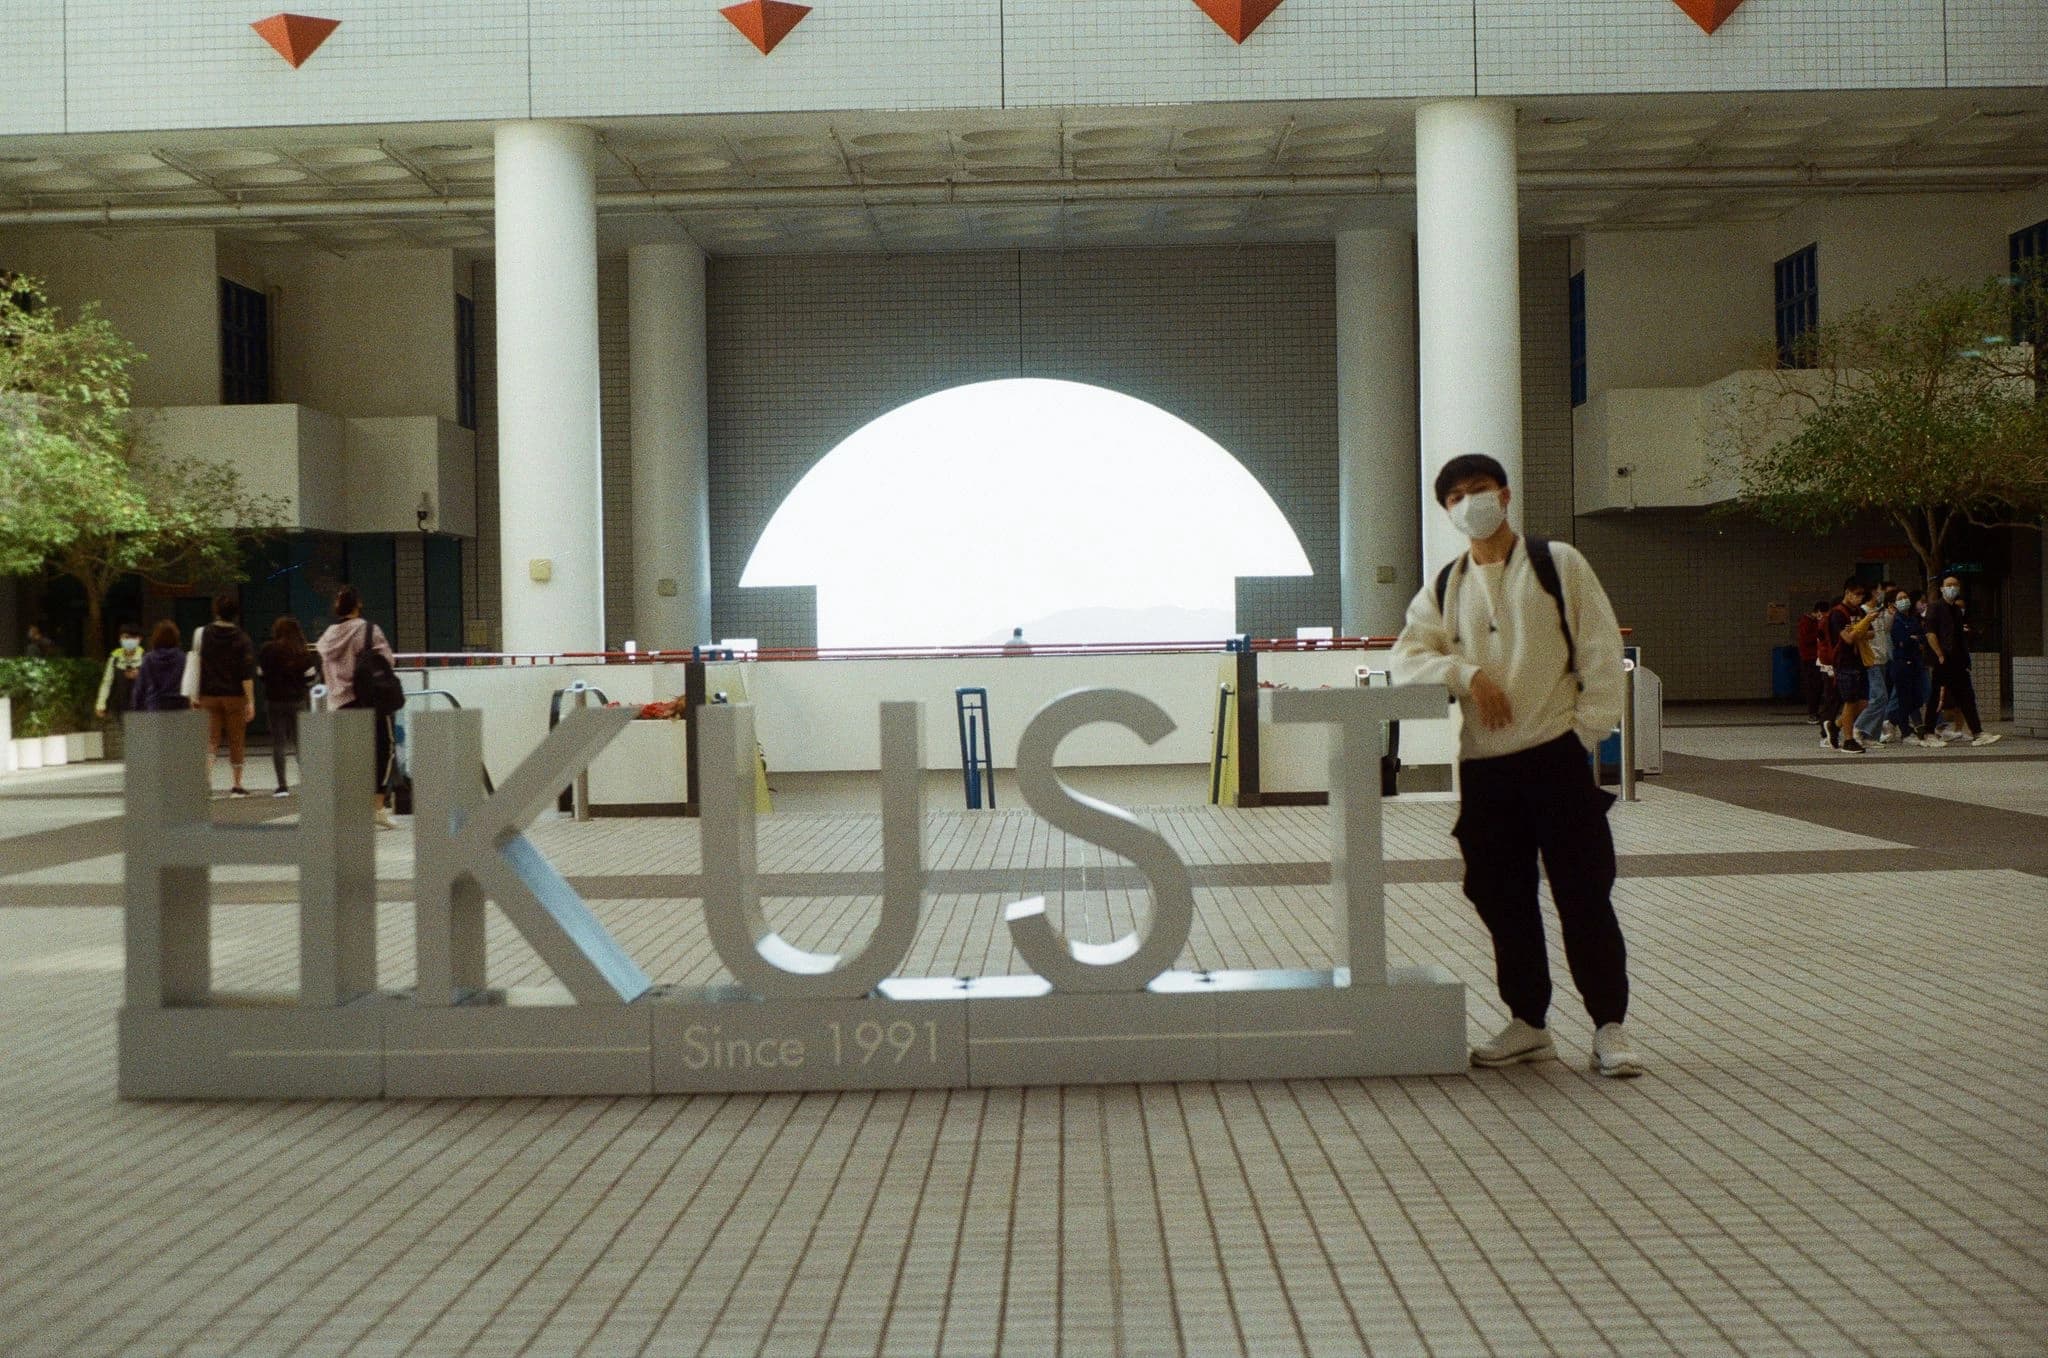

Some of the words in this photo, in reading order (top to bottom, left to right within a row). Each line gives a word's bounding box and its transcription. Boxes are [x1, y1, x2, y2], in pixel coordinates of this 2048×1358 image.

[122, 685, 1450, 1007] HKUST
[683, 1024, 805, 1070] Since
[828, 1020, 940, 1066] 1991
